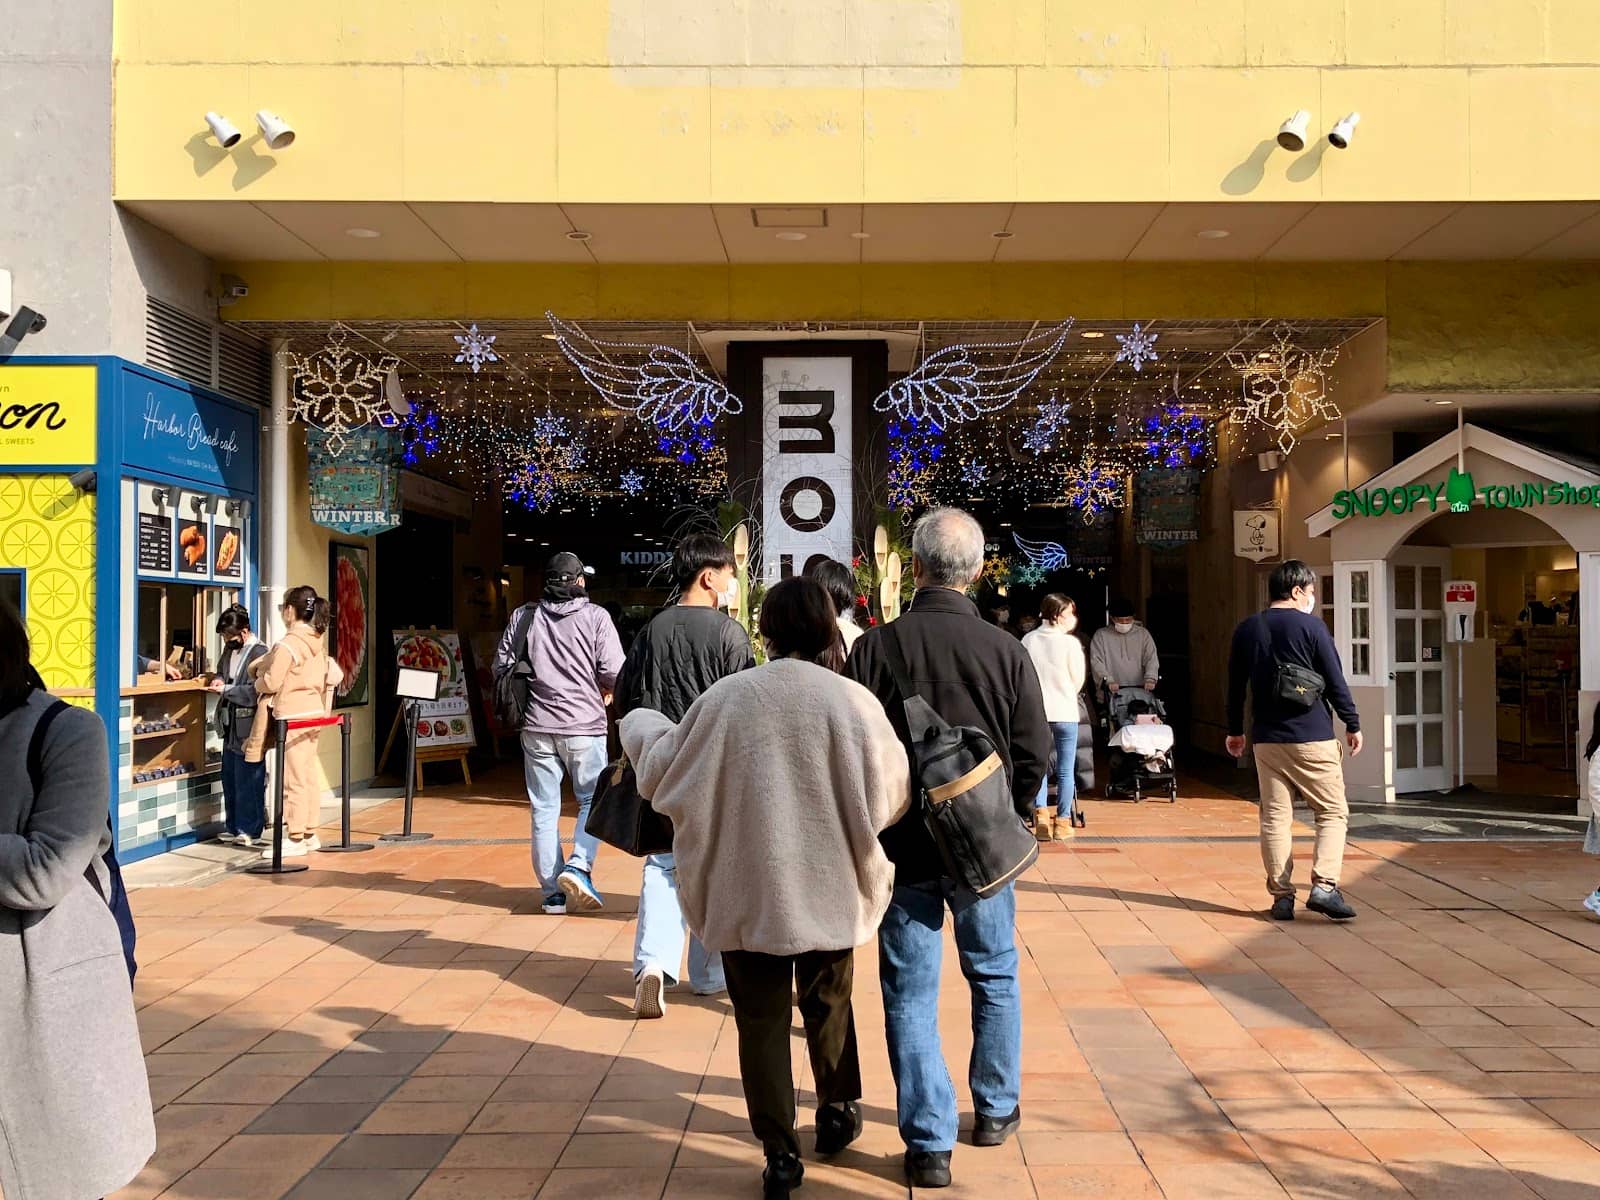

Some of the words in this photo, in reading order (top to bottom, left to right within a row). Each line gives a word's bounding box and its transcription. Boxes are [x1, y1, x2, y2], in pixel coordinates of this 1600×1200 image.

[143, 392, 186, 440] Harbor
[187, 412, 219, 450] Bread
[220, 430, 239, 467] cafe
[1331, 481, 1445, 519] SNOOPY
[1479, 482, 1544, 509] TOWN
[312, 510, 386, 523] WINTER
[1143, 530, 1198, 540] WINTER
